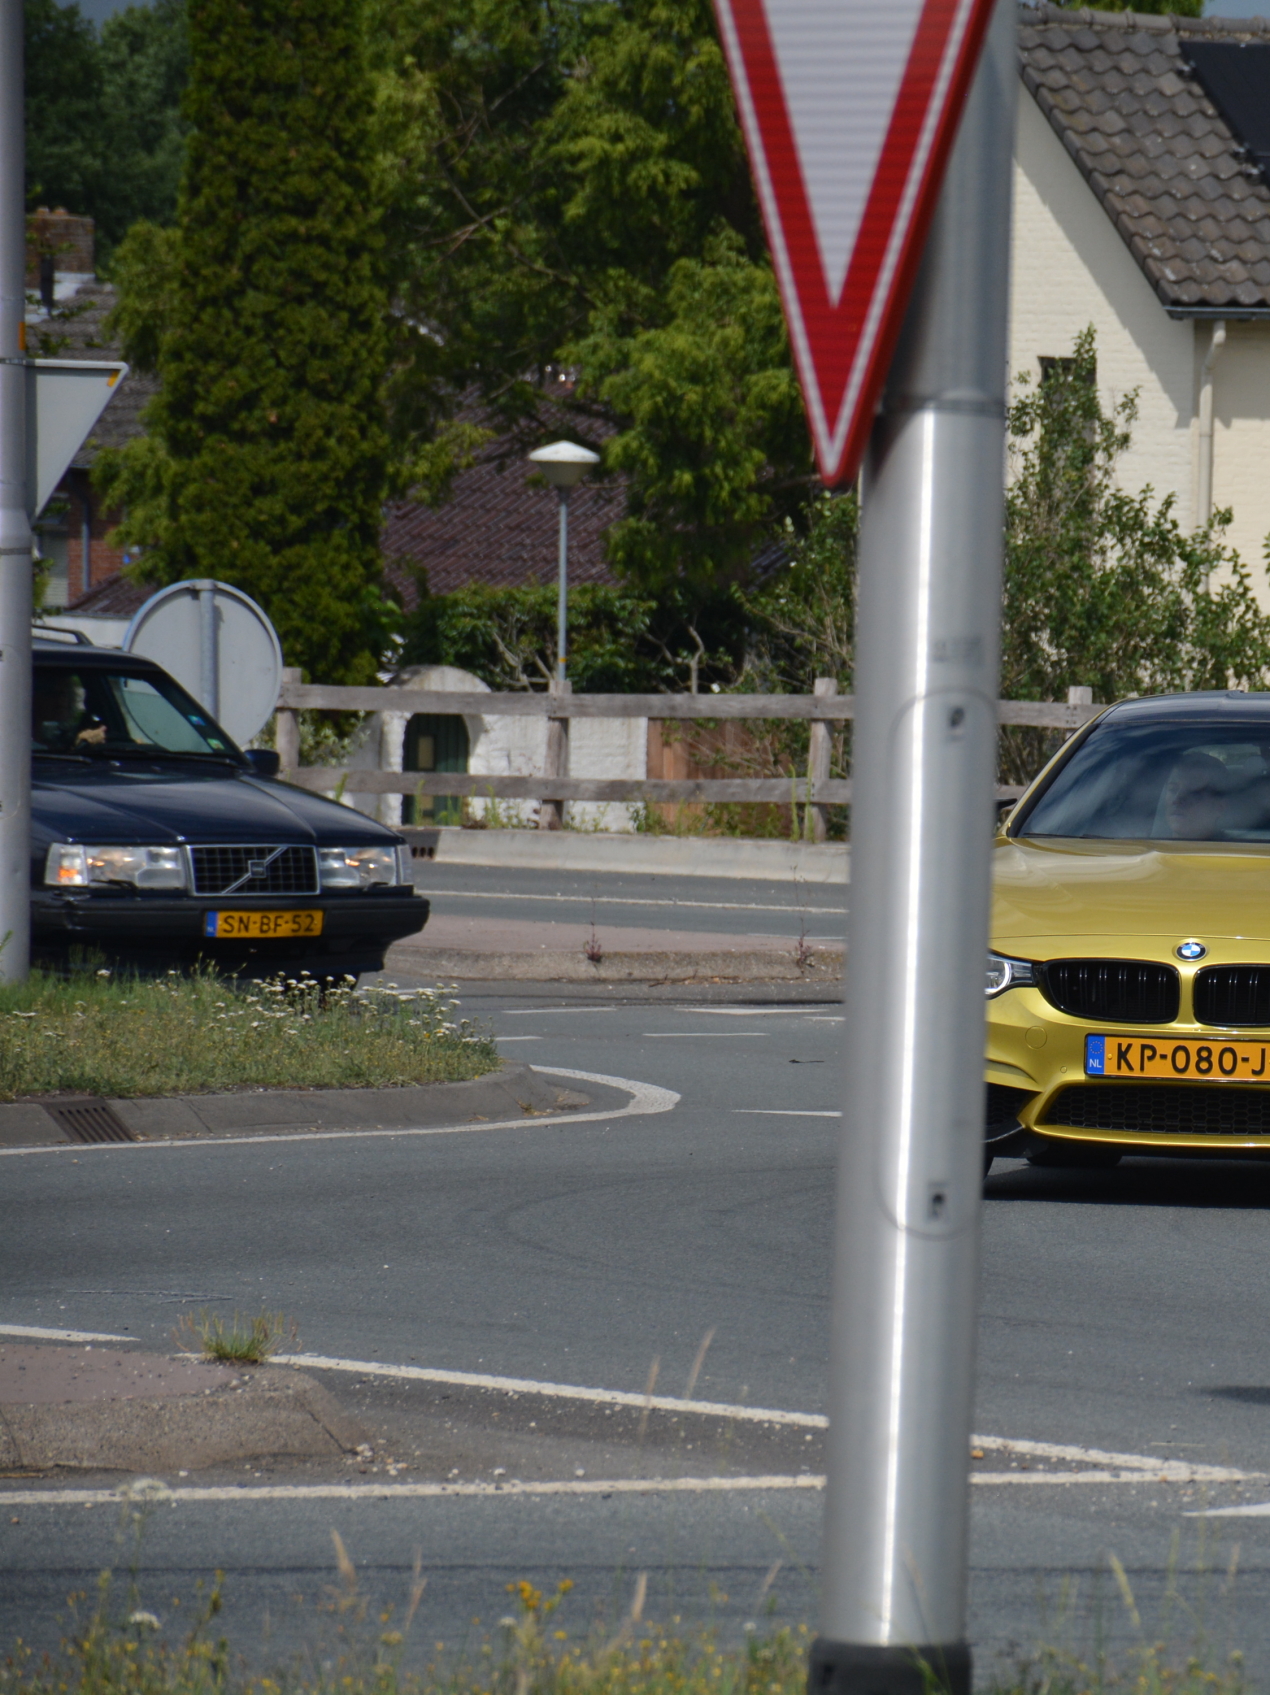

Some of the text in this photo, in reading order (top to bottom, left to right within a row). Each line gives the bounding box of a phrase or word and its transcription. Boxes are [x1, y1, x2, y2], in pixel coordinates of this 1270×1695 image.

[222, 914, 315, 934] SN-BF-52
[1089, 1058, 1102, 1068] NL
[1116, 1042, 1266, 1076] KP-080-J
